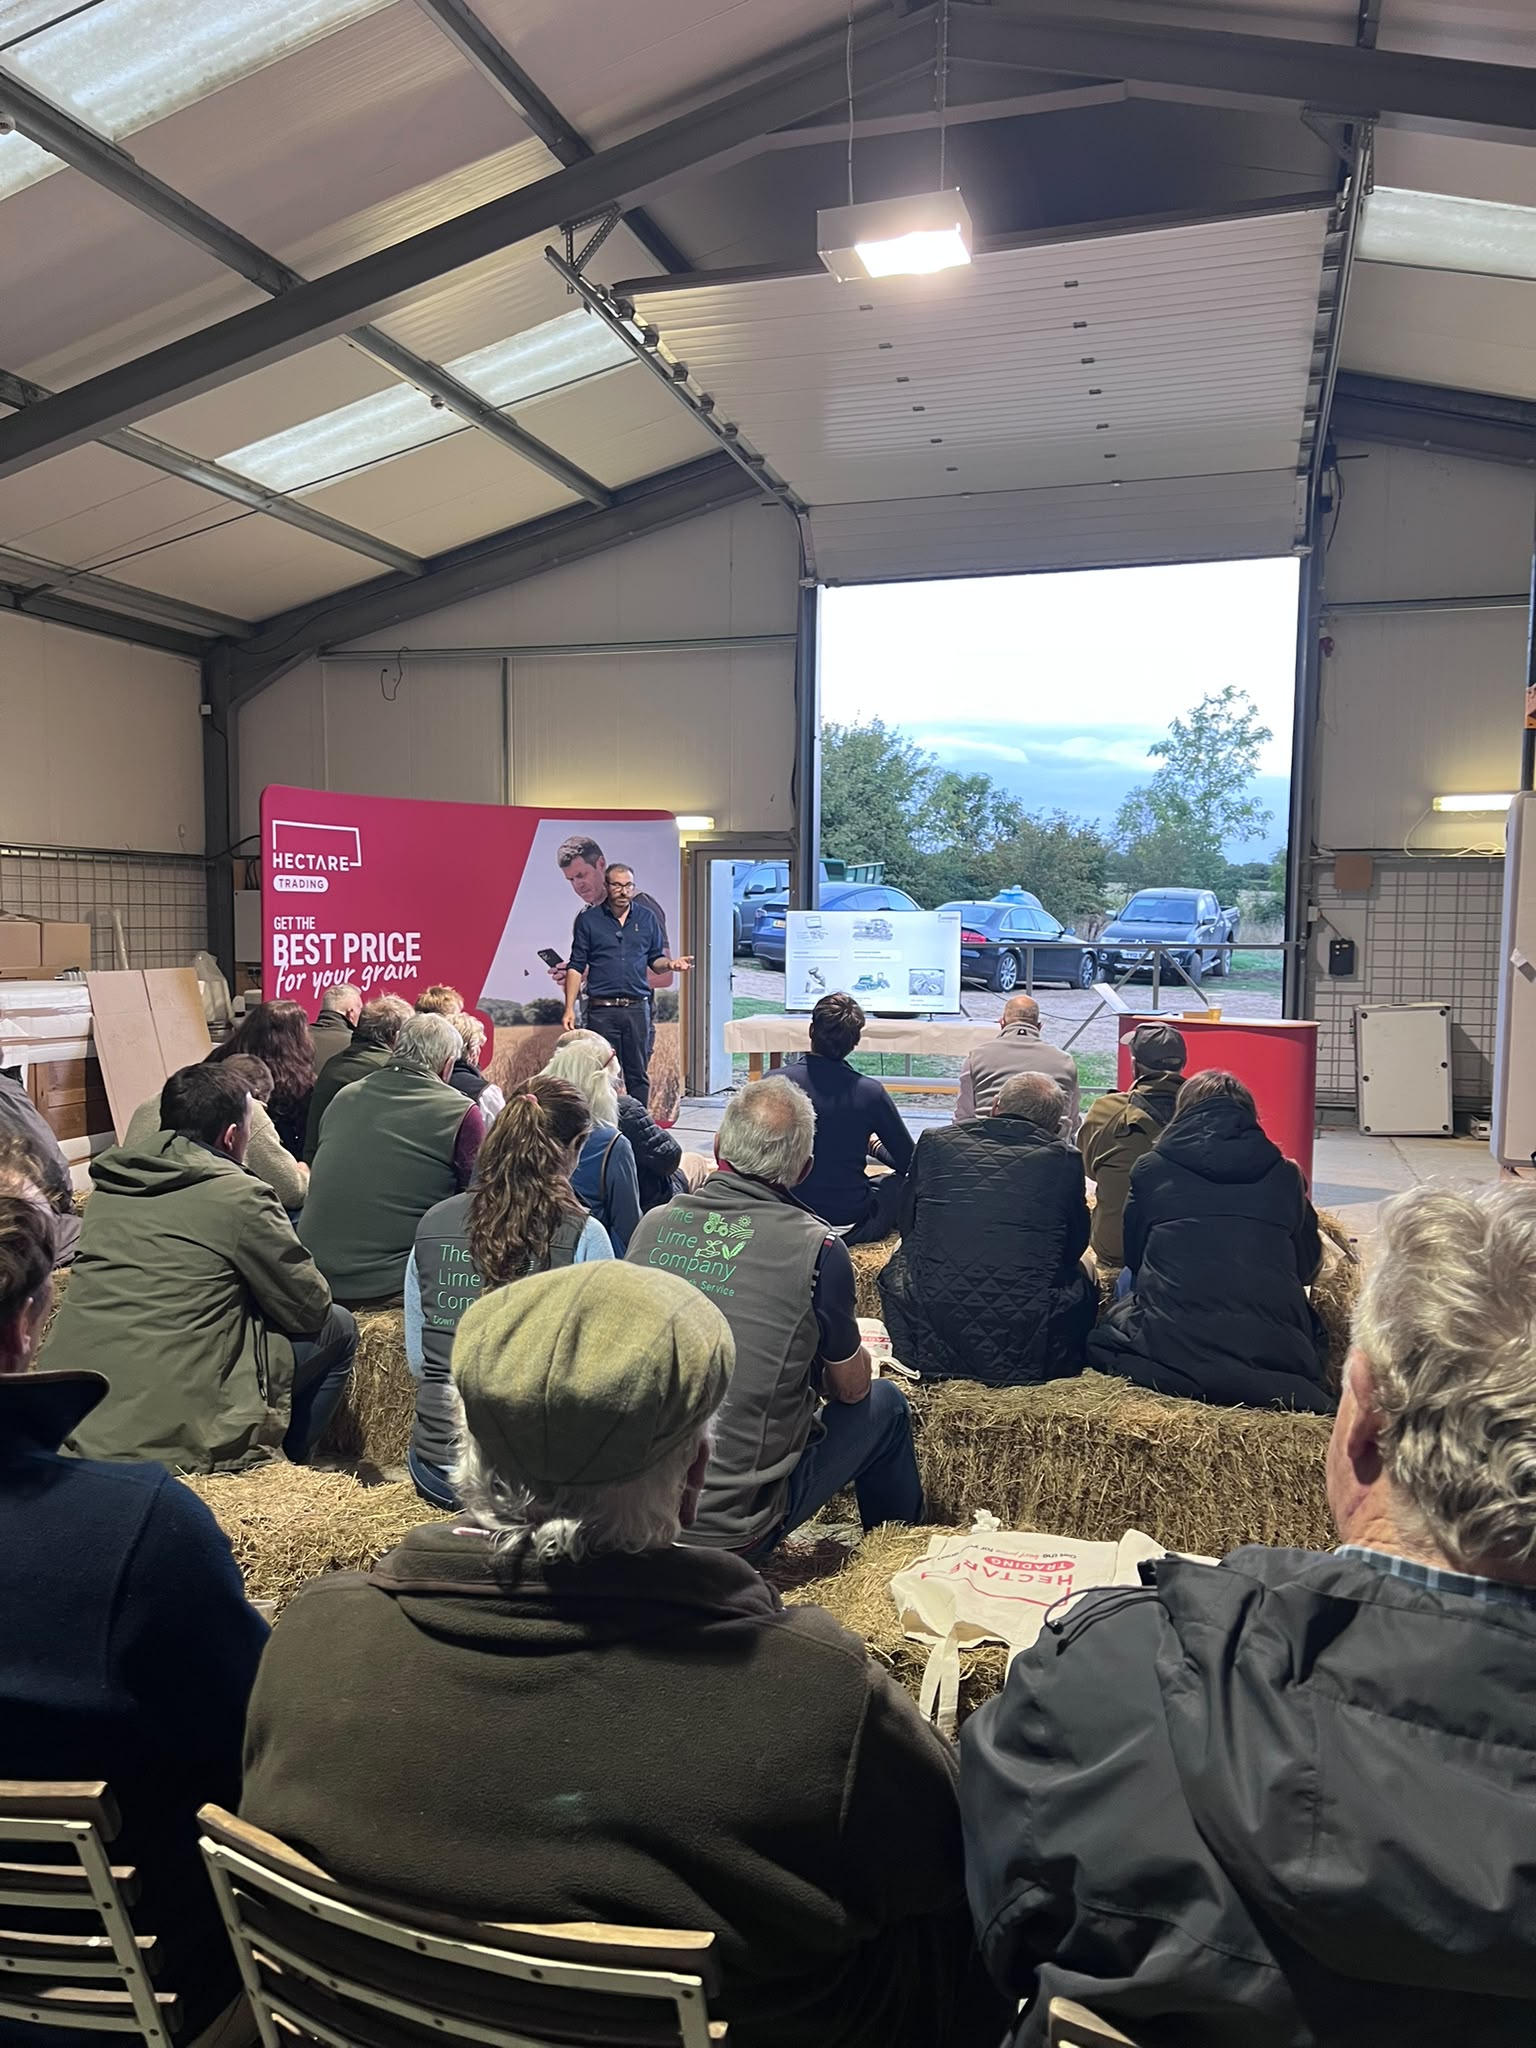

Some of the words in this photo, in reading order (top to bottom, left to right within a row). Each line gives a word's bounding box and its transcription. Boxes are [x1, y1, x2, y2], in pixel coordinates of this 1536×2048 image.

[273, 852, 349, 872] HECTARE
[278, 878, 325, 889] TRADING
[273, 916, 294, 930] GET
[295, 916, 316, 930] THE
[273, 933, 337, 967] BEST
[343, 932, 422, 964] PRICE
[275, 962, 307, 999] for
[312, 967, 356, 999] your
[361, 963, 418, 992] grain
[656, 1225, 698, 1249] Lime
[440, 1244, 471, 1263] The
[648, 1247, 737, 1283] Company
[438, 1268, 481, 1287] Lime
[700, 1280, 735, 1297] Service
[991, 1557, 1067, 1571] TRADING
